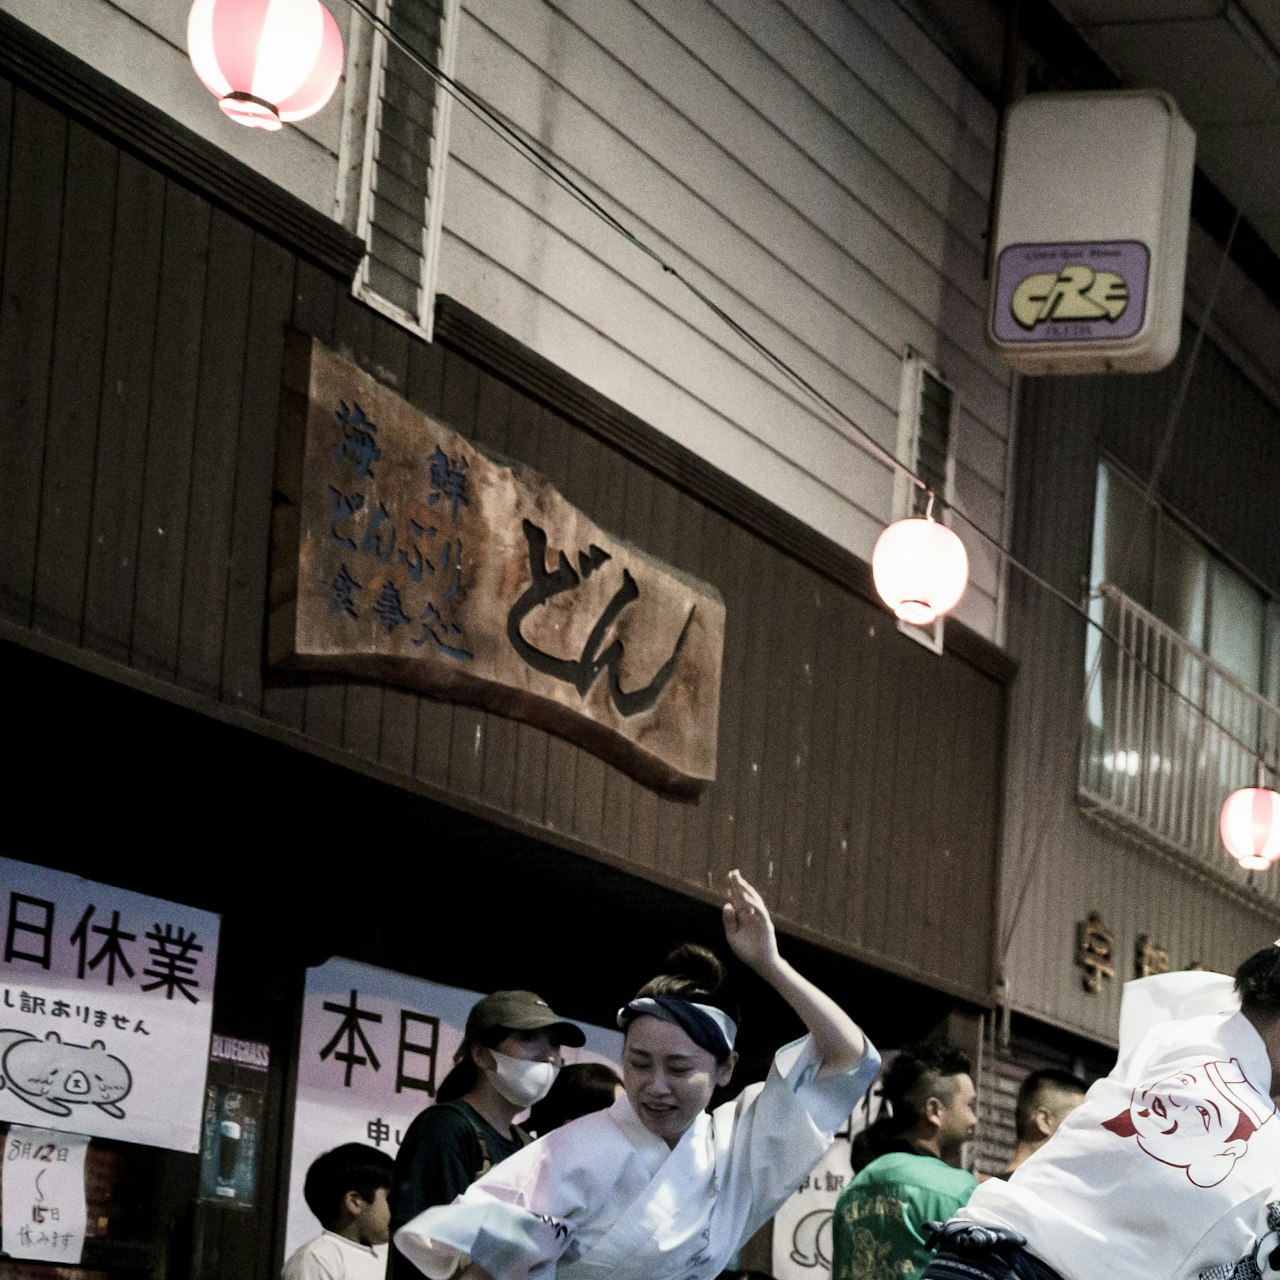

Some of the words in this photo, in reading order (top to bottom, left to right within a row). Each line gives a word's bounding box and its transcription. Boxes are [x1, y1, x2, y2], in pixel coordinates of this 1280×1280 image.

[505, 518, 697, 717] どん
[3, 890, 204, 1005] 日休業
[317, 988, 441, 1098] 本日
